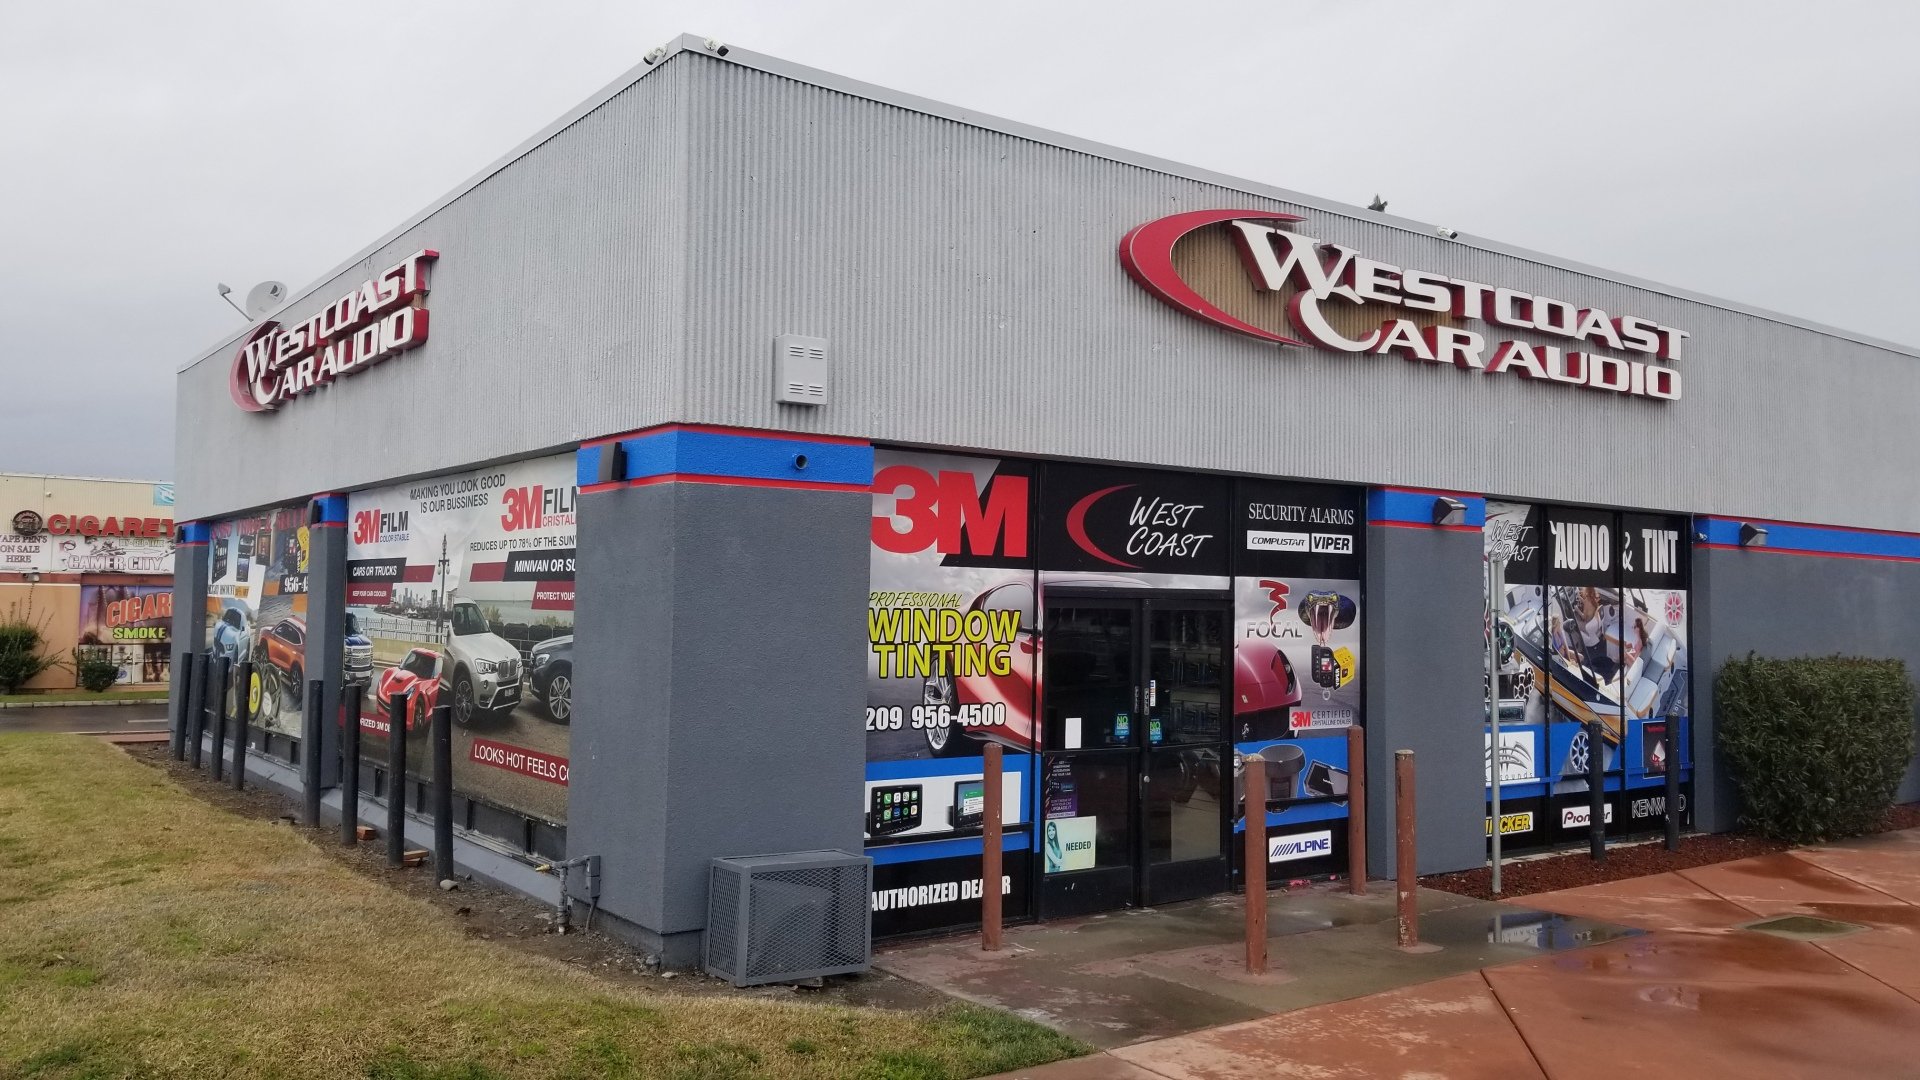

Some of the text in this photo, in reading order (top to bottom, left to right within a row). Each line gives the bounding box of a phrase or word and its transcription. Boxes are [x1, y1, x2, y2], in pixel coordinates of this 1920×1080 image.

[1232, 219, 1690, 361] WESTCOAST
[244, 249, 428, 384] WESTCOAST
[1295, 288, 1682, 401] CAR AUDIO
[256, 307, 415, 405] CAR AUDIO
[410, 474, 506, 500] MAKING YOU LOOK GOOD
[420, 493, 489, 514] IS OUR BUSSINESS
[501, 484, 543, 532] 3M
[870, 465, 1029, 558] 3M
[1129, 496, 1204, 529] WEST
[1248, 502, 1354, 525] SECURITY ALARMS
[353, 508, 409, 545] 3M FILM
[543, 514, 577, 527] CRISTAL
[1491, 519, 1533, 542] WEST
[0, 534, 20, 543] APE
[17, 545, 40, 553] SALE
[470, 540, 498, 551] REDUCES
[499, 540, 508, 550] UP
[509, 539, 518, 549] TO
[533, 537, 542, 547] OF
[543, 536, 557, 547] THE
[1126, 526, 1213, 558] COAST
[1251, 535, 1350, 551] COMPUSTAR VIPER
[1552, 521, 1610, 572] AUDIO
[1641, 528, 1679, 574] TINT
[6, 555, 32, 563] HERE
[1490, 540, 1539, 562] COAST
[69, 555, 163, 571] GAMER CITY
[352, 565, 398, 577] CARS OR TRUCKS
[514, 559, 549, 573] MINIVAN
[550, 559, 564, 572] OR
[284, 575, 309, 593] 956-4
[536, 591, 560, 601] PROTECT
[869, 591, 963, 608] PROFESSIONAL
[105, 592, 174, 628] CIGAR
[113, 627, 167, 639] SMOKE
[868, 608, 1021, 643] WINDOW
[1246, 621, 1302, 639] FOCAL
[872, 643, 1011, 679] TINTING
[866, 702, 1006, 731] 209 956-4500
[1291, 709, 1351, 728] 3M CERTIFIED
[474, 743, 505, 764] LOOKS
[506, 751, 526, 770] HOT
[527, 756, 557, 778] FEELS
[1631, 794, 1686, 819] KENWD
[1563, 811, 1610, 825] Pionr
[1065, 840, 1092, 851] NEEDED
[1290, 838, 1330, 856] ALPINE
[871, 875, 1011, 912] AUTHORIZED DEAR
